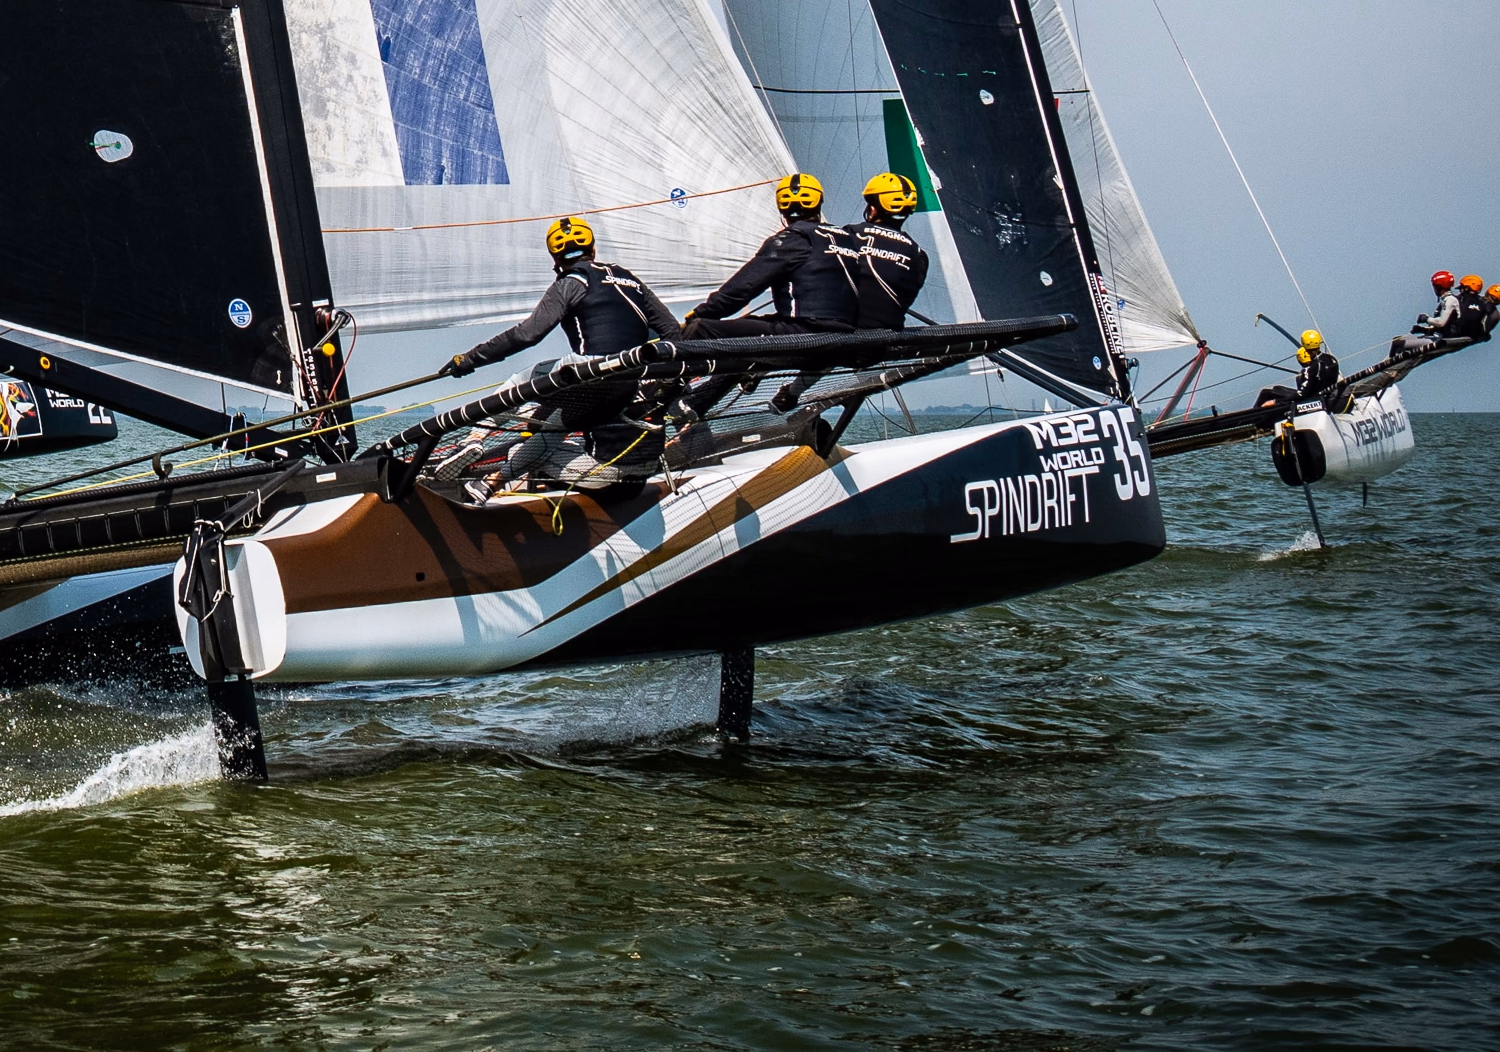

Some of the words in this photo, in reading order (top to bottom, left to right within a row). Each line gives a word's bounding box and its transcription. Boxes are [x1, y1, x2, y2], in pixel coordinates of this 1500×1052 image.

[858, 246, 912, 264] SPINDRIFT
[49, 399, 84, 408] WORLD
[1021, 413, 1100, 450] M32
[1350, 418, 1378, 447] M32
[1039, 447, 1105, 472] WORLD
[1099, 407, 1150, 501] 35
[950, 466, 1099, 544] SPINDRIFT
